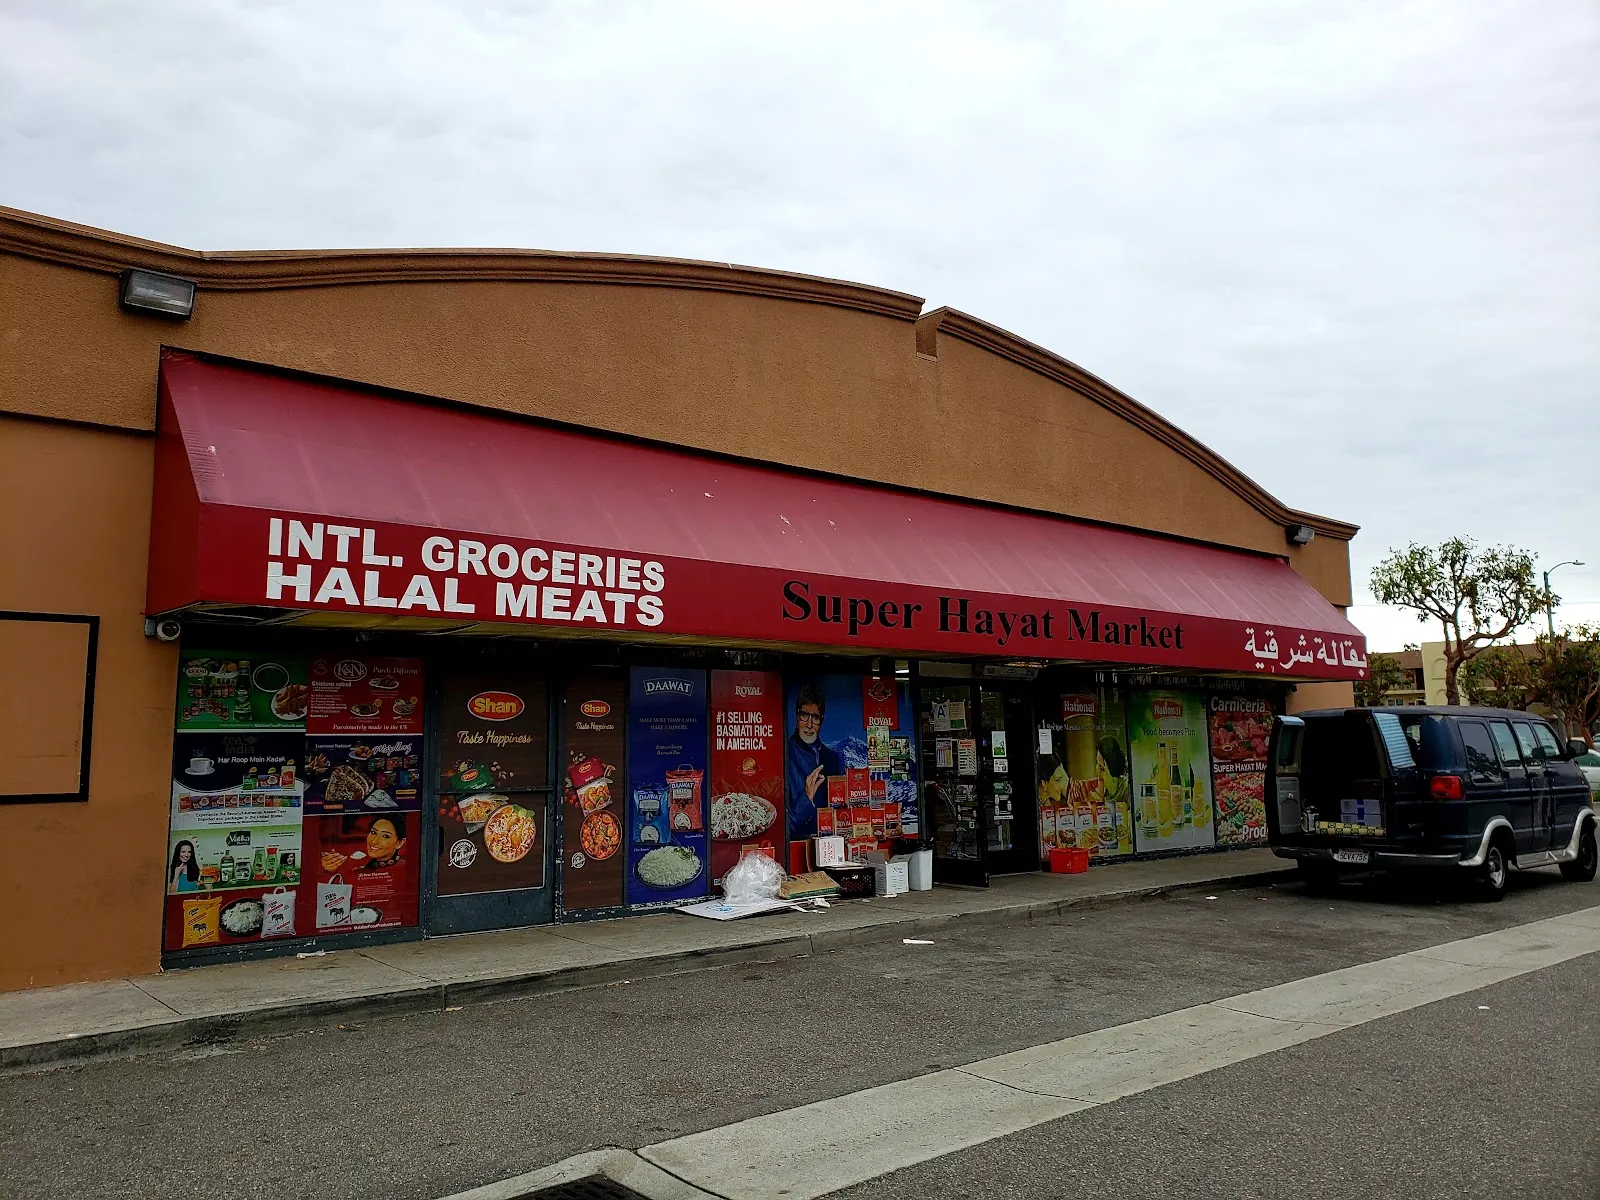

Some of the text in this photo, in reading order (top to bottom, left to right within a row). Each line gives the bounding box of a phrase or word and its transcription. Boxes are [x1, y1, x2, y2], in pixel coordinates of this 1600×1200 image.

[268, 518, 665, 592] INTL. GROCERIES
[265, 561, 665, 626] HALAL MEATS
[782, 580, 1184, 650] Super Hayat Market
[1244, 627, 1368, 677] بقالة شرقية
[373, 666, 418, 676] Purely Different
[646, 681, 692, 693] DAAWAT
[734, 686, 762, 697] ROYAL
[473, 697, 517, 714] Shan
[583, 703, 606, 713] Shan
[1063, 698, 1096, 713] National
[1154, 701, 1181, 715] National
[1211, 696, 1266, 712] Carniceria
[716, 711, 762, 724] #1 SELLING
[936, 706, 945, 718] A
[590, 722, 615, 732] Happiness
[869, 716, 893, 727] ROYAL
[716, 724, 773, 737] BASMATI RICE
[1143, 727, 1196, 736] Food becomes Fun
[457, 730, 533, 748] Taste Happiness
[716, 738, 766, 750] IN AMERICA.
[218, 756, 230, 764] Har
[231, 756, 249, 764] Roop
[1213, 763, 1235, 773] SUPER
[1235, 762, 1255, 772] HAYAT
[850, 790, 867, 798] ROYAL
[1242, 824, 1269, 840] Prod
